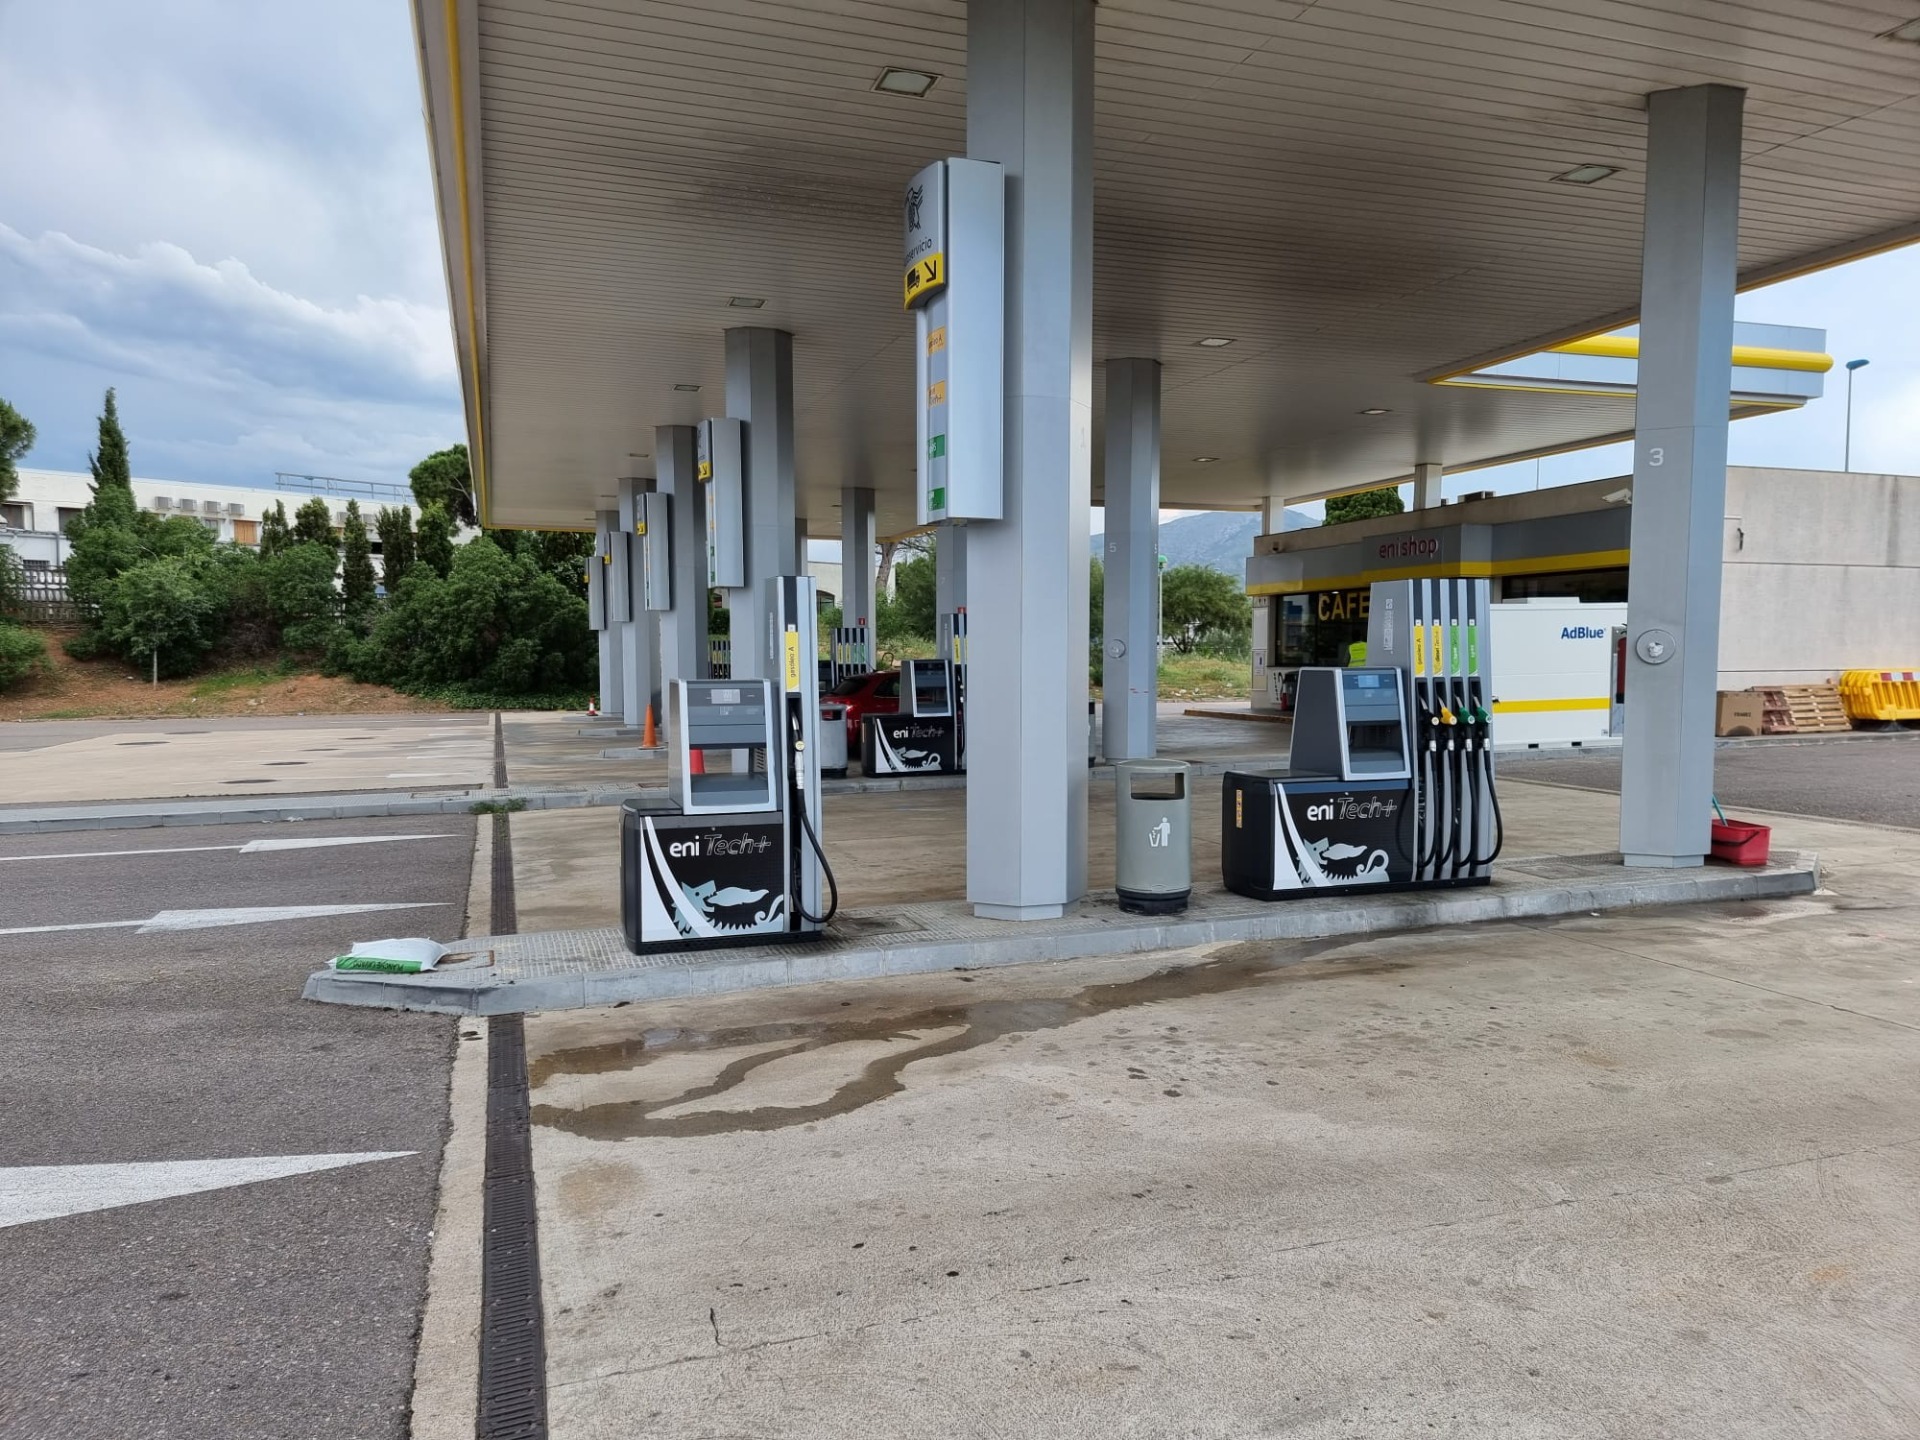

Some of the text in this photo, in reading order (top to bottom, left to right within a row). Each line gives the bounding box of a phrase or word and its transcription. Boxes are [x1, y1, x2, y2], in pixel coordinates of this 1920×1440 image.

[1648, 447, 1665, 467] 3
[1108, 542, 1117, 553] 5
[893, 727, 909, 739] eni
[1307, 796, 1397, 822] eni Tech+
[669, 832, 772, 858] eni Tech+
